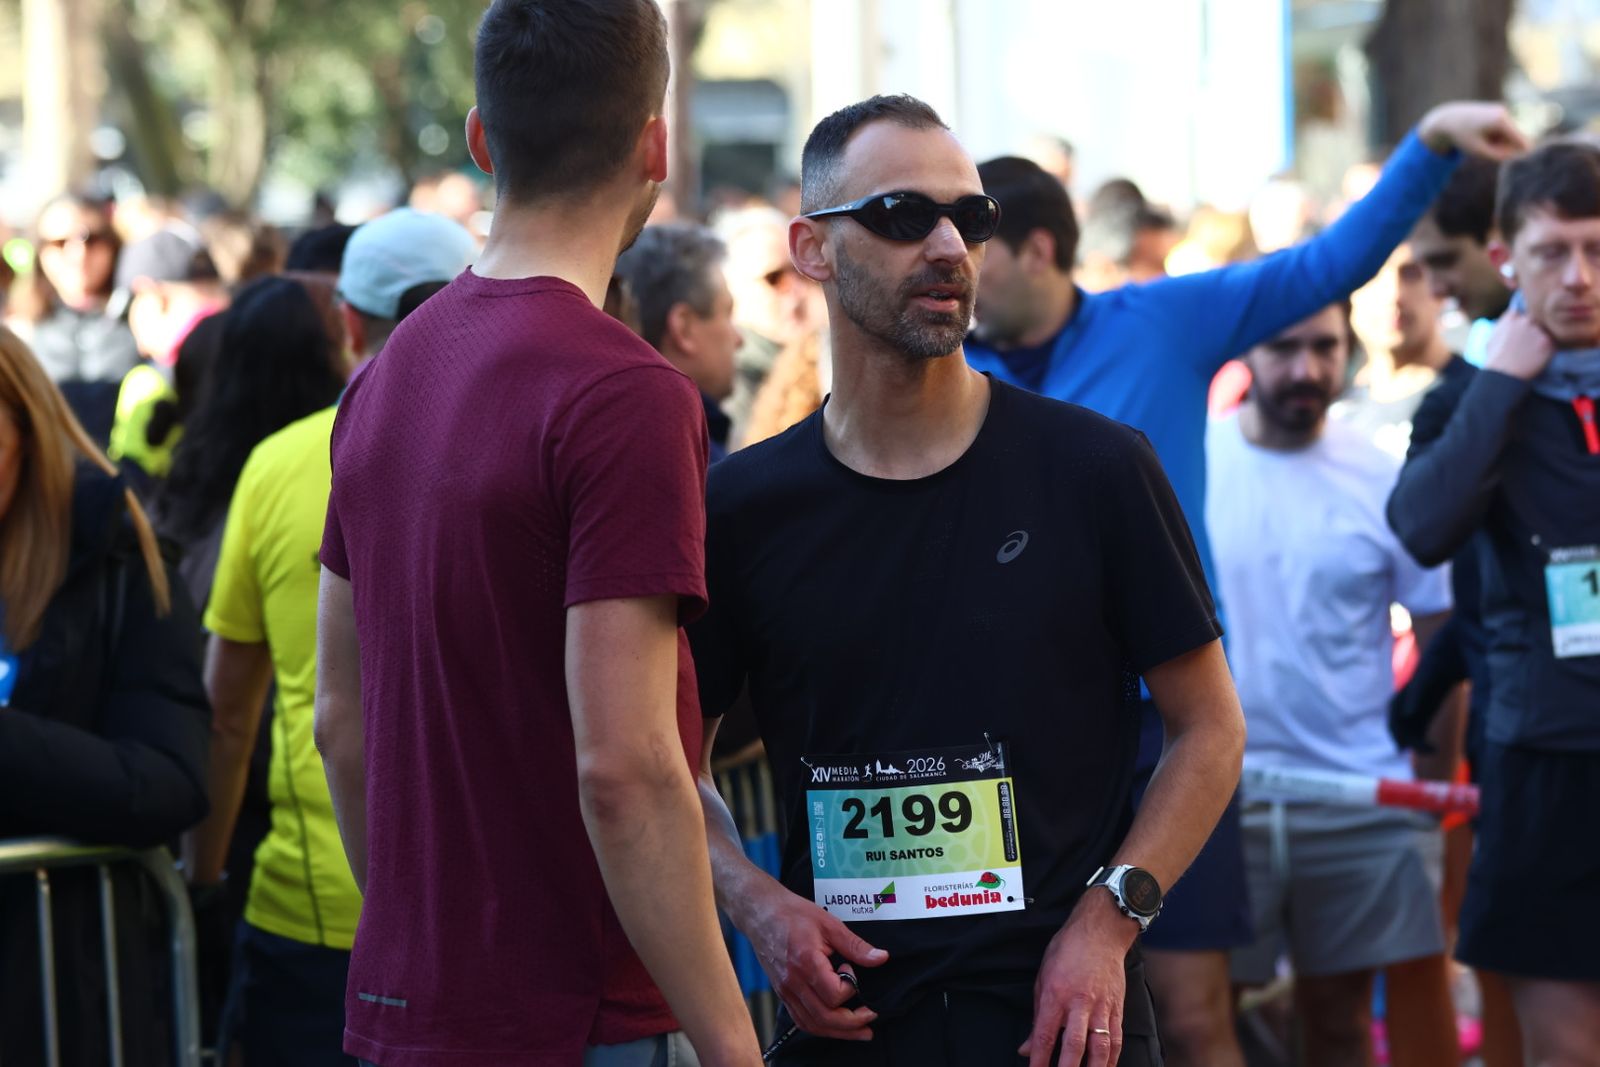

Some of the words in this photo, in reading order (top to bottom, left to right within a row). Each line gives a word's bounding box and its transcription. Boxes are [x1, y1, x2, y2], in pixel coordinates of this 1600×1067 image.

[832, 766, 859, 776] MEDIA
[906, 757, 946, 774] 2026
[811, 767, 832, 783] XIV
[909, 771, 947, 779] SALAMANCA
[842, 791, 972, 839] 2199
[865, 851, 886, 861] RUI
[889, 847, 944, 860] SANTOS
[924, 882, 974, 892] FLORISTERÍAS
[825, 893, 872, 905] LABORAL
[925, 890, 1002, 909] bedunia
[852, 906, 874, 914] kutxa
